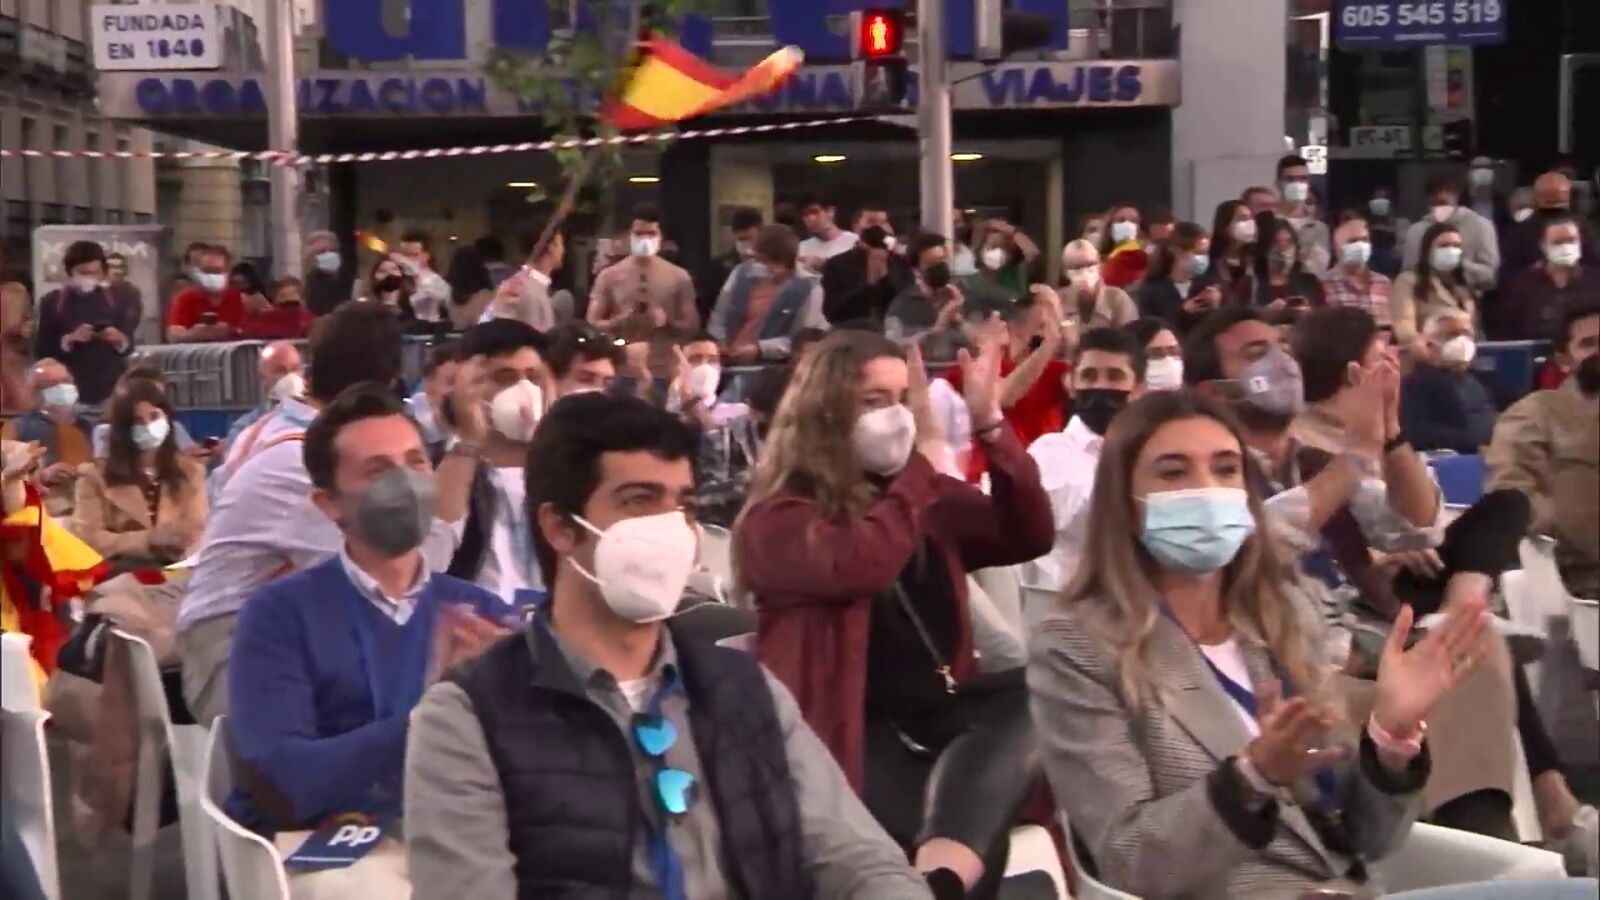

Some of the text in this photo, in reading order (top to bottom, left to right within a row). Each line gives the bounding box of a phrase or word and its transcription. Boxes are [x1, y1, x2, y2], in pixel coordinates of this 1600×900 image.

[103, 14, 205, 32] FUNDADA
[1342, 0, 1501, 27] 605 545 519
[107, 43, 135, 60] EN
[979, 65, 1142, 105] VIAJES
